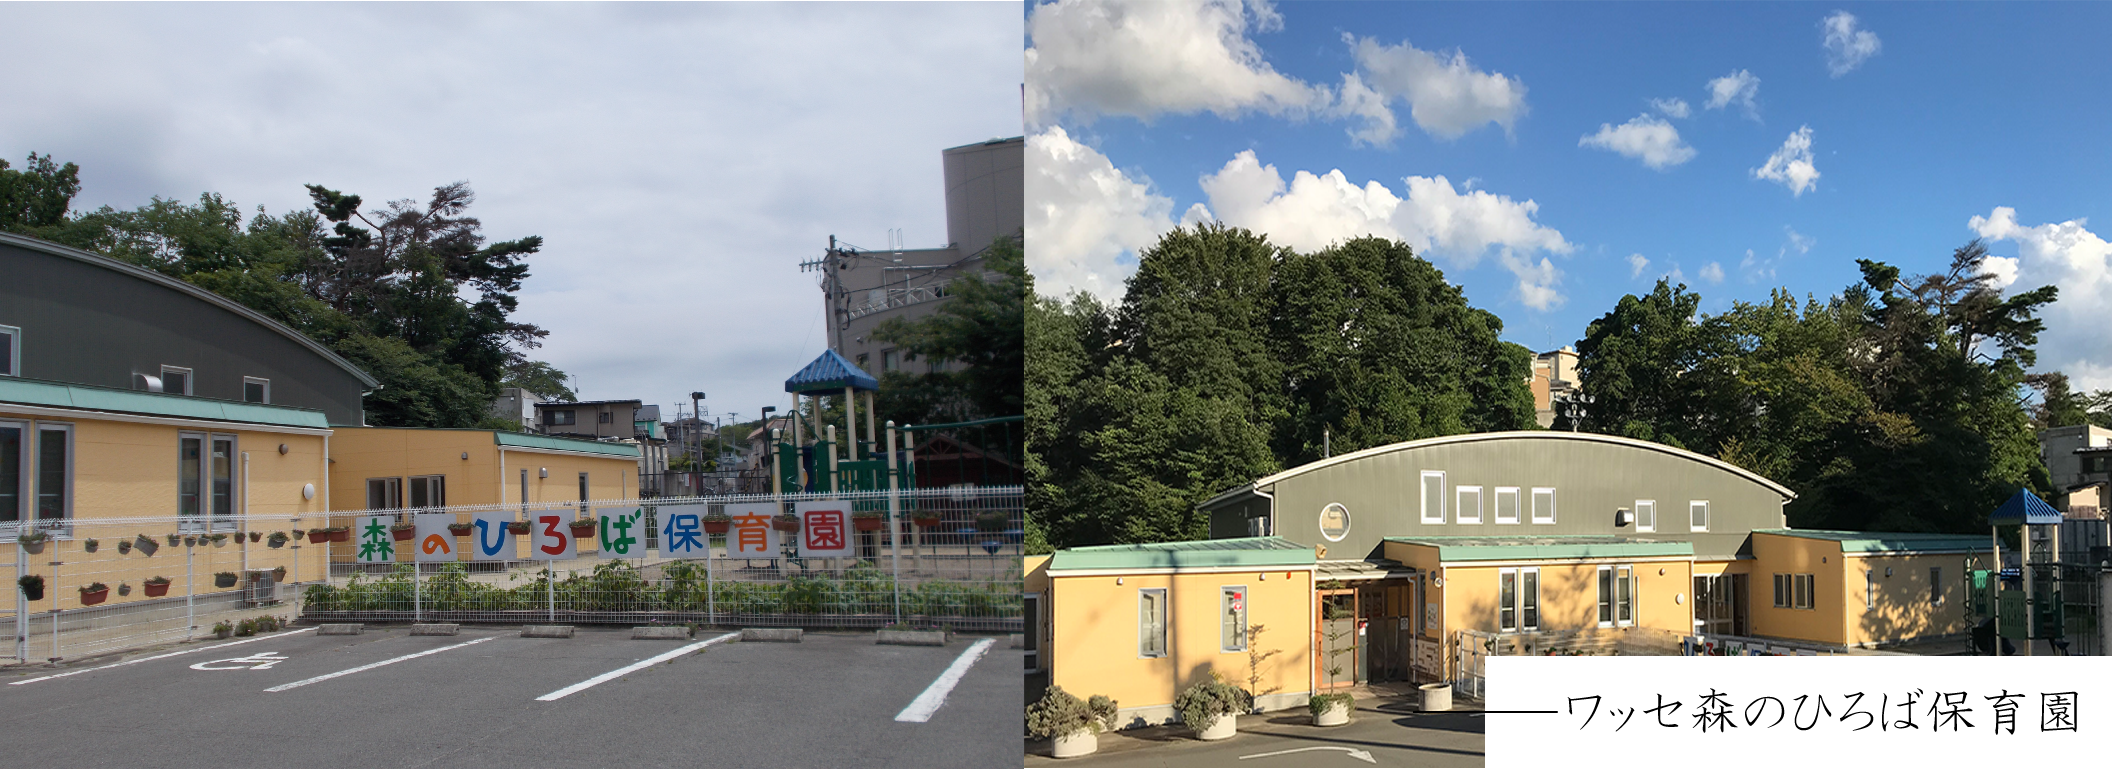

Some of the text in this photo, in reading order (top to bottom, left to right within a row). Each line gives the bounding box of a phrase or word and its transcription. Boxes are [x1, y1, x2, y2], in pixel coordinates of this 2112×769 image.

[358, 508, 846, 561] 森のひろば保育園
